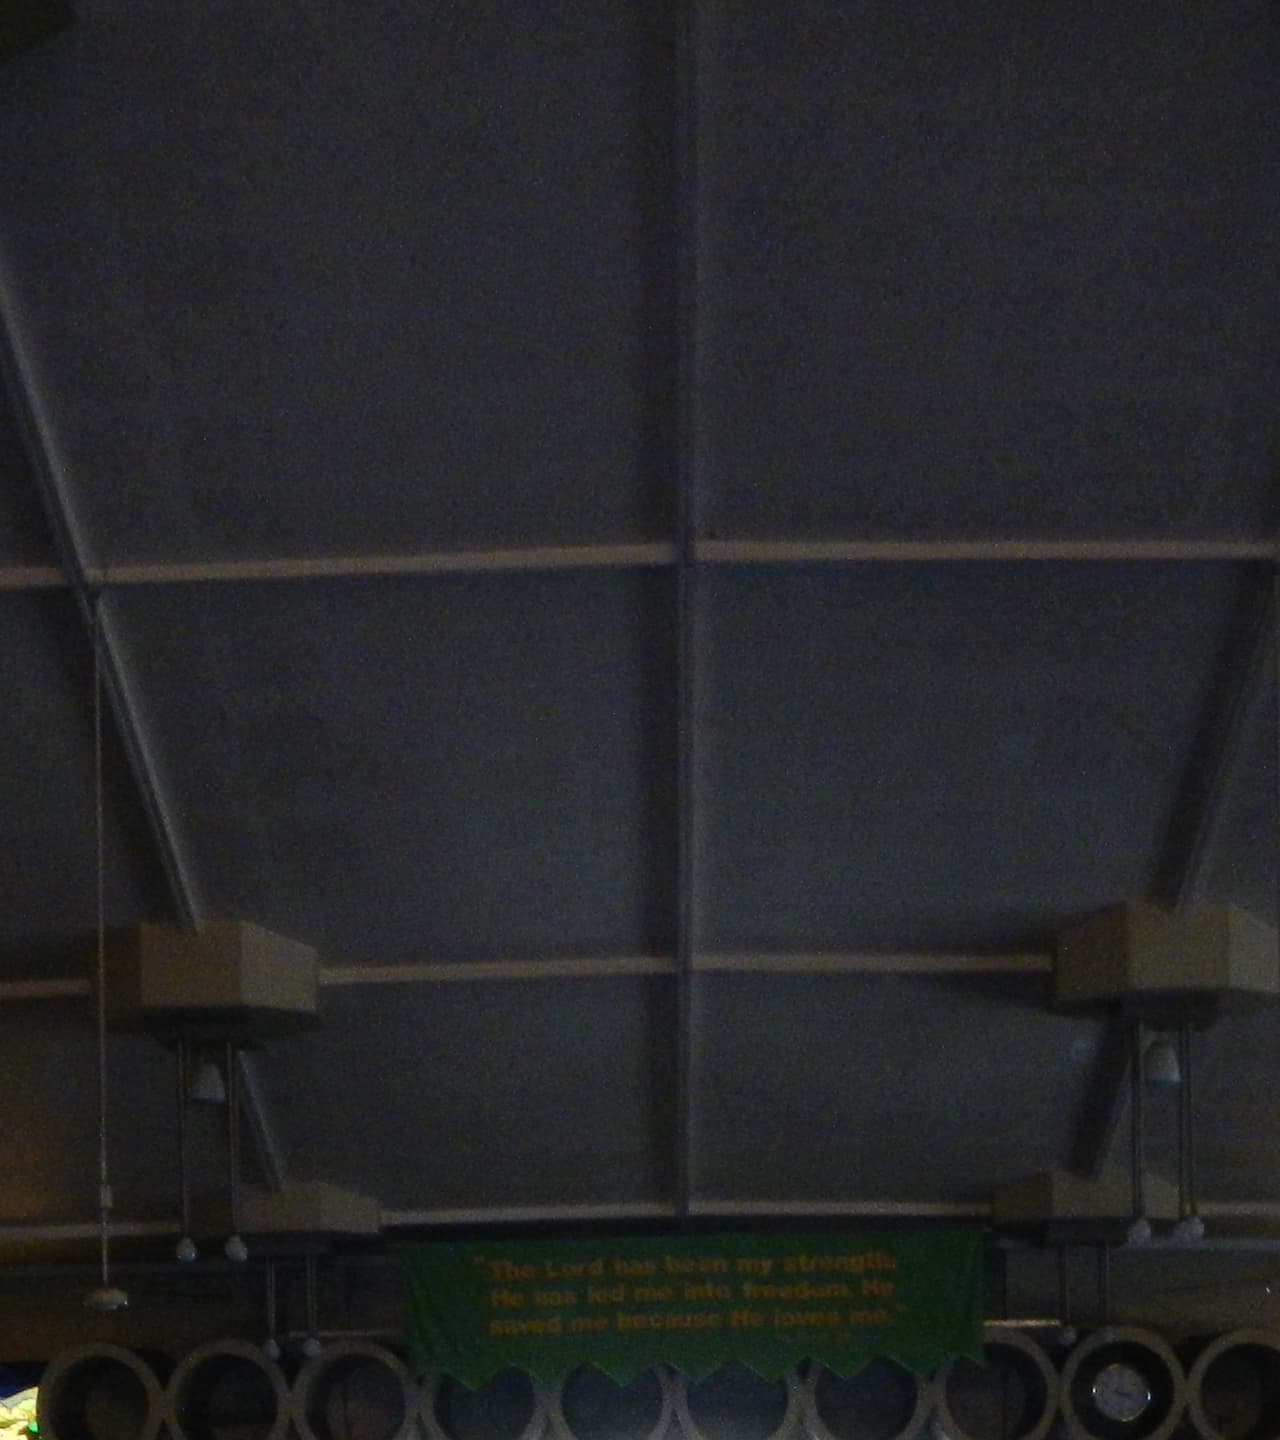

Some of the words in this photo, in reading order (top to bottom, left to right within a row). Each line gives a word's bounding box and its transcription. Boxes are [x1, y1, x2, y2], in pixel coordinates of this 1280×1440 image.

[544, 1258, 604, 1280] Lord
[612, 1257, 657, 1277] has
[663, 1254, 729, 1275] been
[735, 1257, 773, 1277] my
[616, 1311, 723, 1330] because
